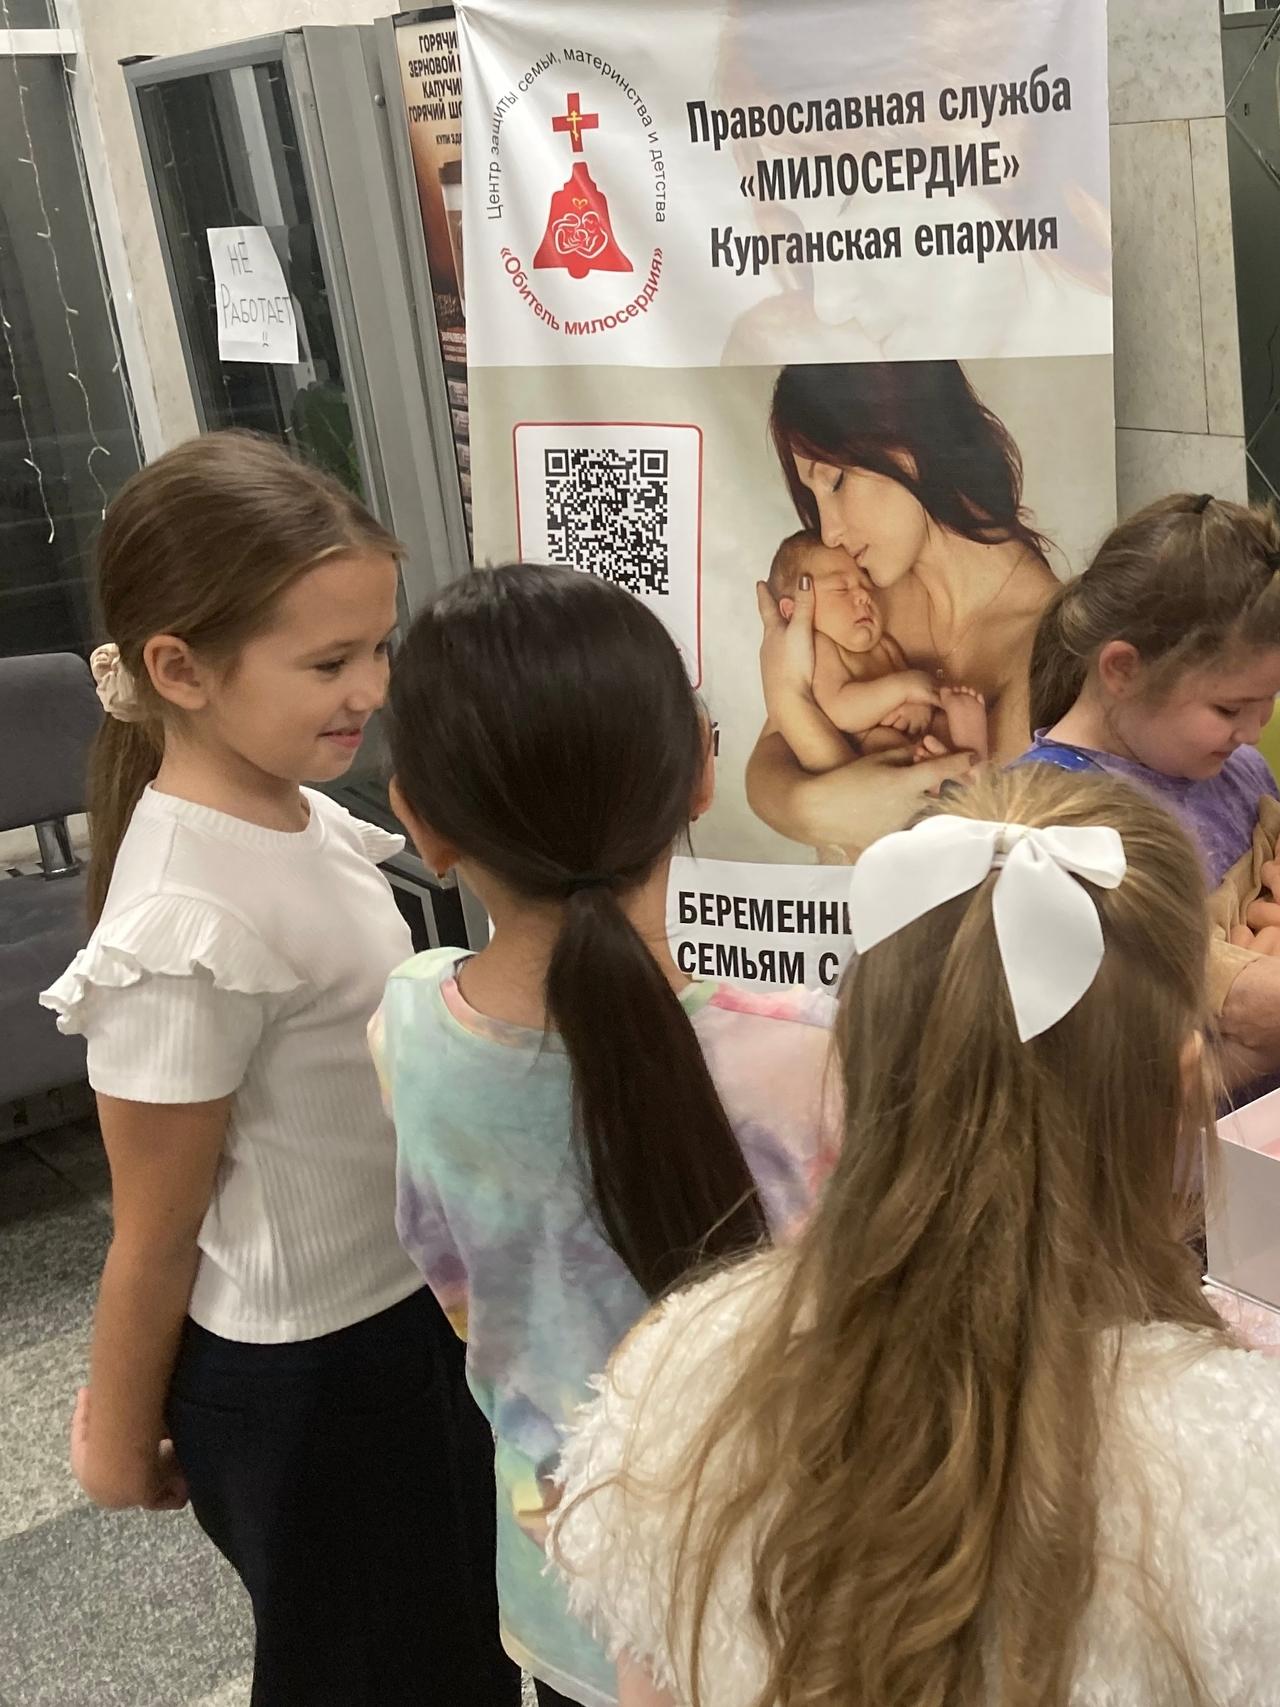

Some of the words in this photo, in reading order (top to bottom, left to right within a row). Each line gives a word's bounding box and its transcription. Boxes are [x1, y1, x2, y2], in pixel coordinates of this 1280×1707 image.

[408, 50, 457, 78] ЗЕРНОВОЙ
[419, 30, 459, 54] ГОРЯЧИ
[422, 77, 462, 99] КАПУЧИ
[518, 52, 561, 92] семьи,
[564, 48, 653, 128] материнства
[408, 97, 447, 123] ГОРЯЧИЙ
[491, 94, 518, 154] защиты
[687, 90, 925, 151] Православная
[938, 64, 1072, 128] служба
[648, 131, 659, 143] и
[487, 163, 502, 220] Центр
[650, 149, 666, 222] детства
[739, 141, 1020, 202] «МИЛОСЕРДИЕ»
[227, 241, 253, 276] НЕ
[710, 225, 902, 277] Курганская
[914, 216, 1059, 264] епархия
[220, 283, 292, 329] РАБОТАЕТ
[500, 247, 561, 331] «Обитель
[564, 247, 663, 335] милосердия»
[677, 940, 805, 985] СЕМЬЯМ
[818, 951, 840, 986] С
